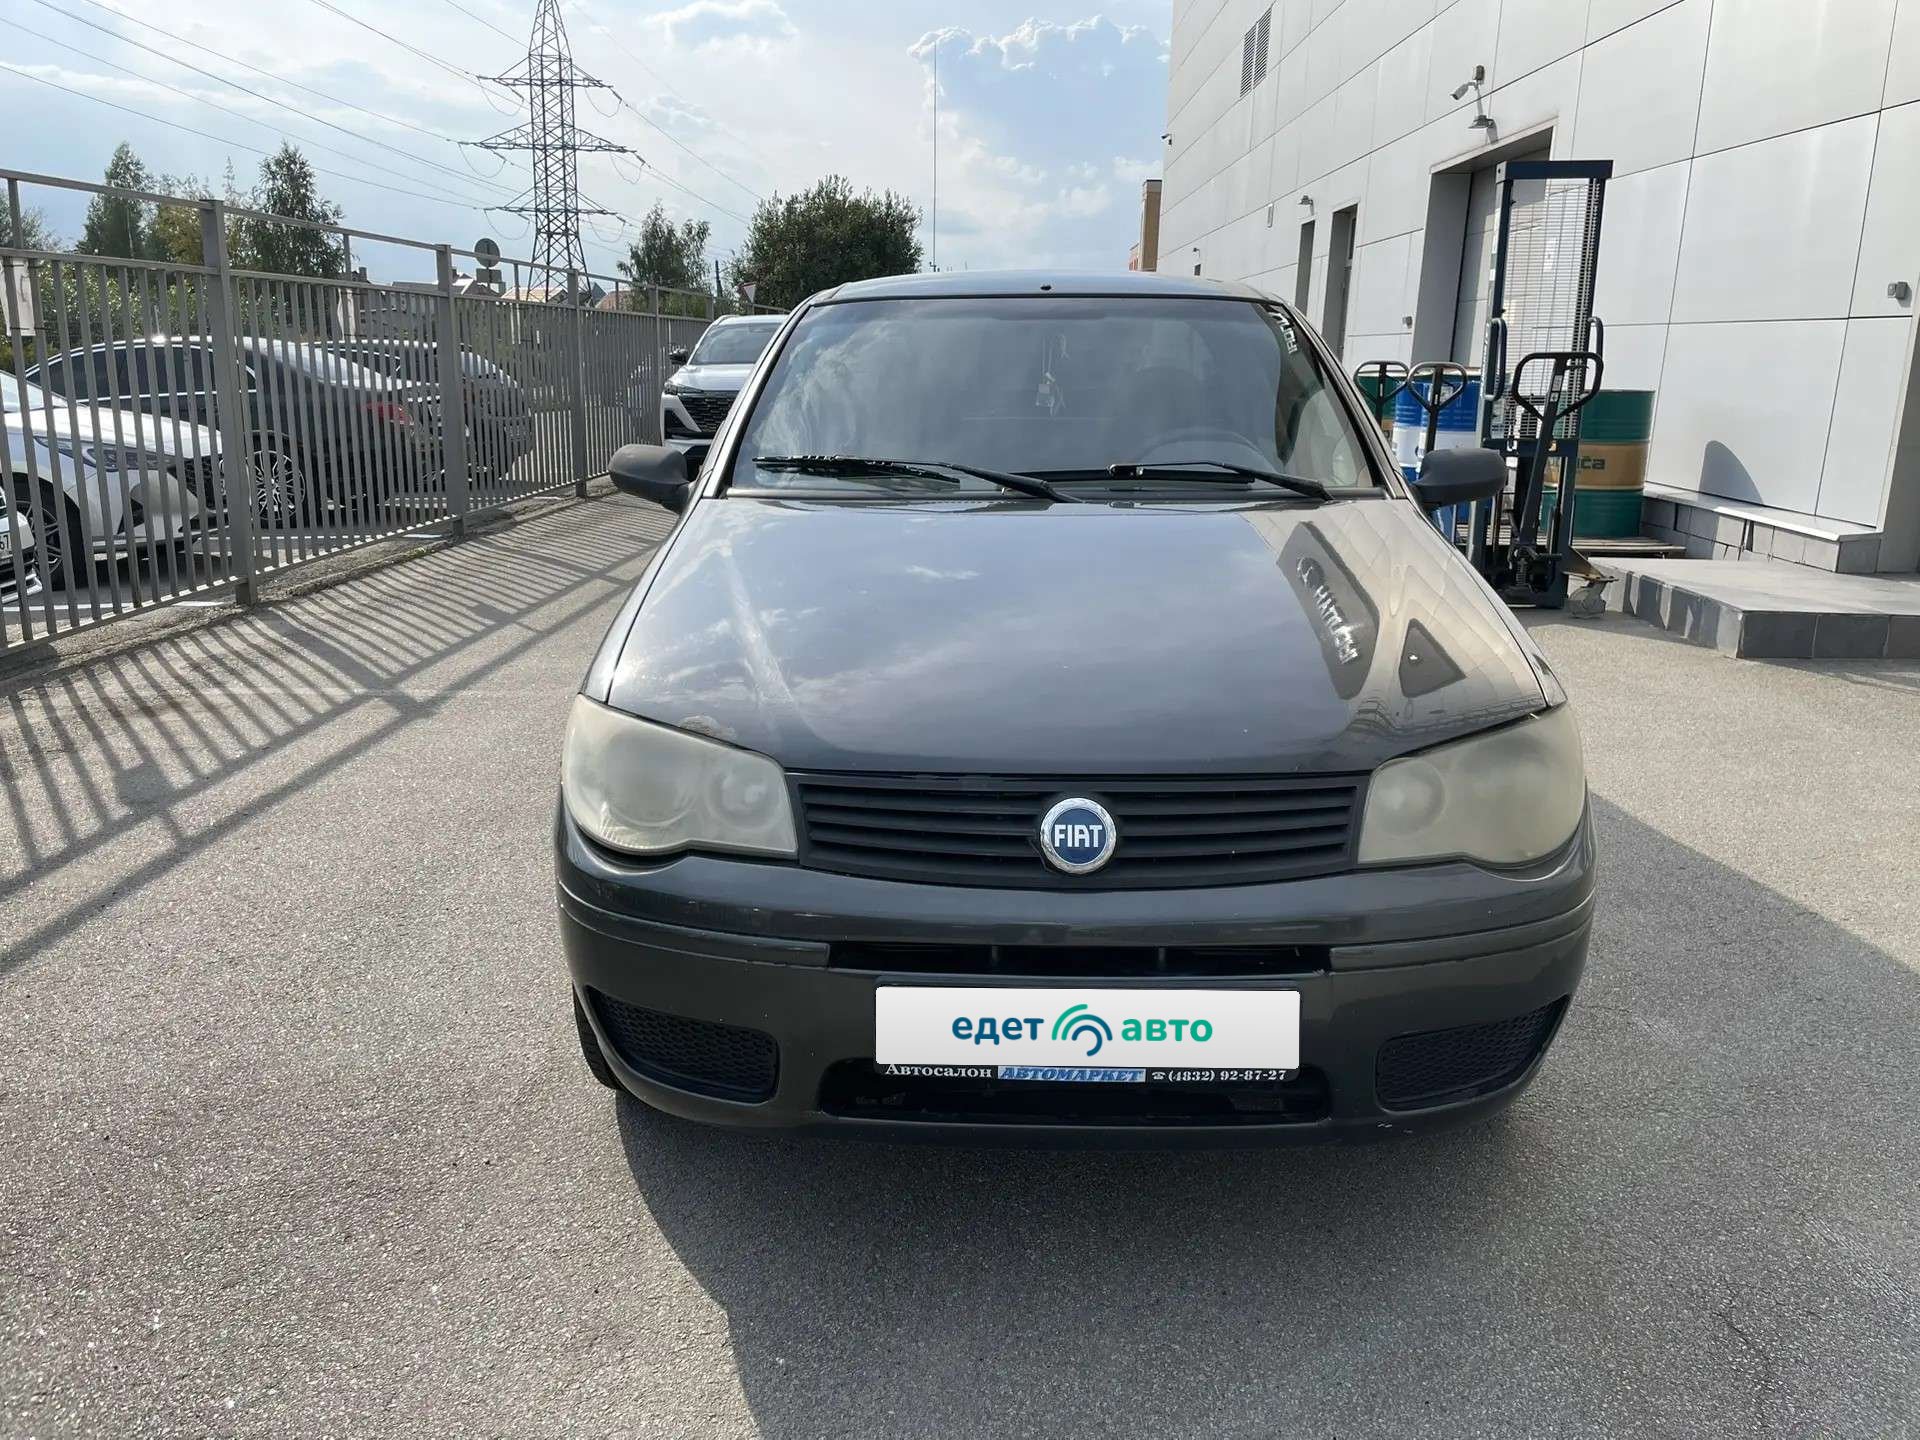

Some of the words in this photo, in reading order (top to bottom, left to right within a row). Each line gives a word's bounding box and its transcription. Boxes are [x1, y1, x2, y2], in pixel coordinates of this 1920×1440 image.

[1054, 824, 1103, 848] FIAT
[885, 1063, 992, 1078] Автосалон
[1000, 1067, 1144, 1082] АВТОМАРКЕТ
[1168, 1070, 1215, 1082] (4832)
[1220, 1070, 1287, 1081] 92-87-27
